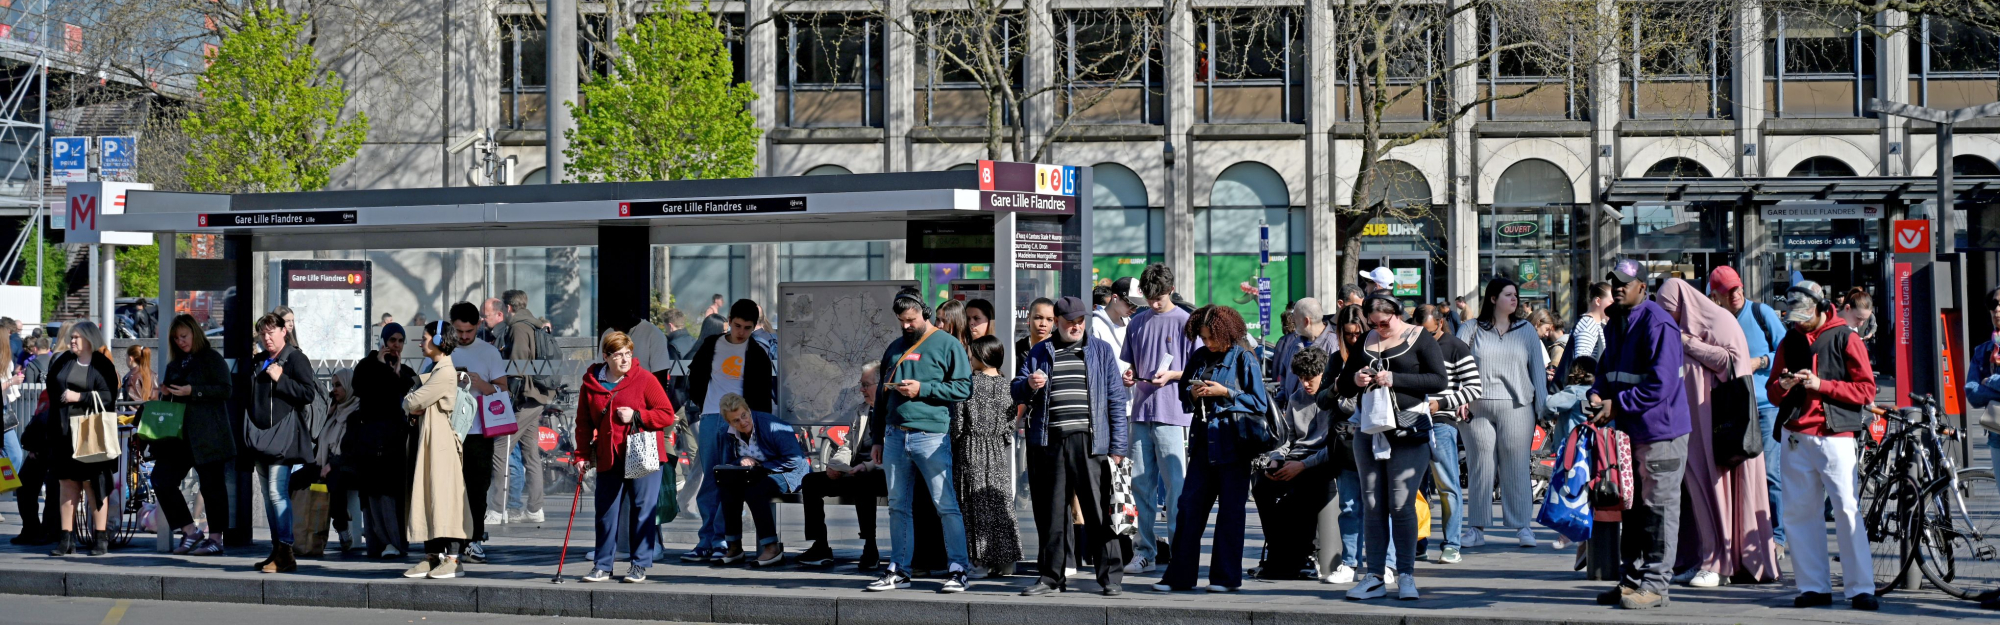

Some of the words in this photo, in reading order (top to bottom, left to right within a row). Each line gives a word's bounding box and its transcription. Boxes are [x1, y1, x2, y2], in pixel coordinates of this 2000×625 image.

[55, 141, 69, 158] P
[104, 140, 118, 157] P
[1040, 172, 1045, 186] 1
[1053, 172, 1059, 186] 2
[1064, 169, 1074, 194] L5
[662, 203, 682, 213] Gare
[685, 203, 702, 212] Lille
[705, 202, 742, 212] Flandres
[990, 193, 1011, 207] Gare
[1012, 194, 1029, 208] Lille
[1031, 195, 1066, 210] Flandres
[71, 194, 96, 231] M
[235, 215, 252, 224] Gare
[253, 214, 269, 224] Lille
[271, 213, 303, 223] Flandres
[1361, 223, 1420, 236] SUBWAY
[1504, 225, 1532, 234] OUVERT
[1015, 242, 1031, 251] ourcoing
[1118, 257, 1147, 265] SUBWAY
[292, 274, 307, 282] Gare
[307, 274, 319, 282] Lille
[320, 274, 347, 282] Flandres
[1901, 270, 1910, 306] Euralille
[1901, 306, 1910, 345] Flandres
